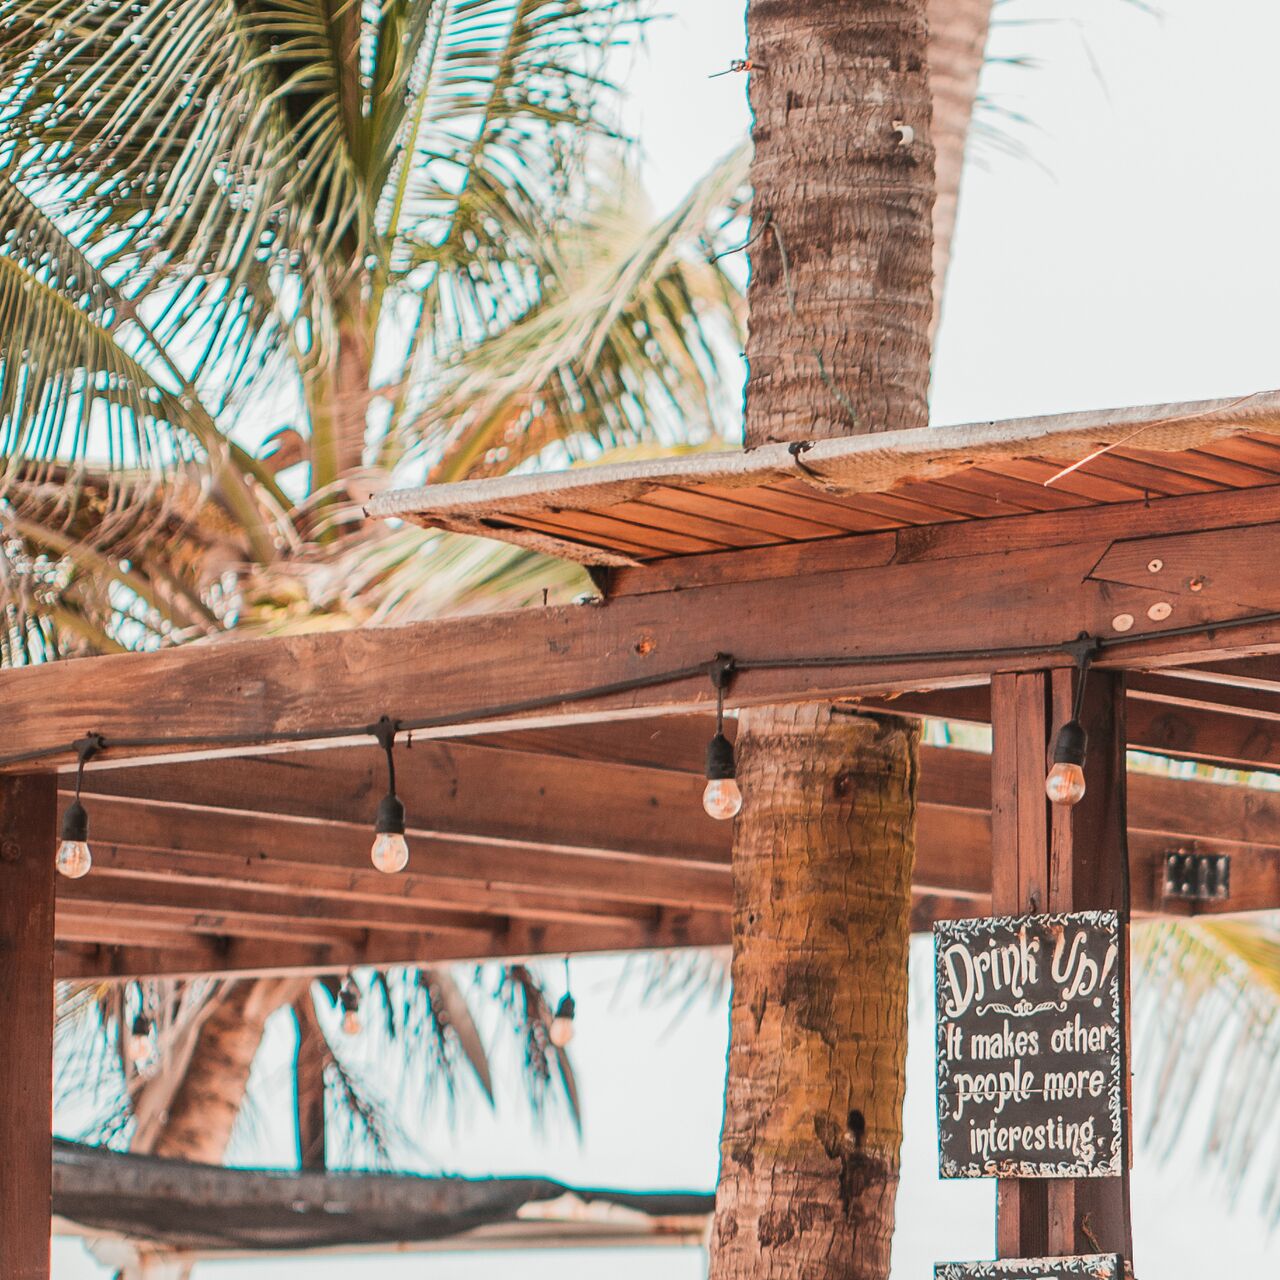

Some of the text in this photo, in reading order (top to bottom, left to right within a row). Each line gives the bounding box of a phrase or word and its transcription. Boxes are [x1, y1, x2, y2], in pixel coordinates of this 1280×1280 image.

[944, 925, 1118, 1018] Drink Up!
[946, 1013, 1114, 1061] It makes other
[953, 1059, 1106, 1121] people more
